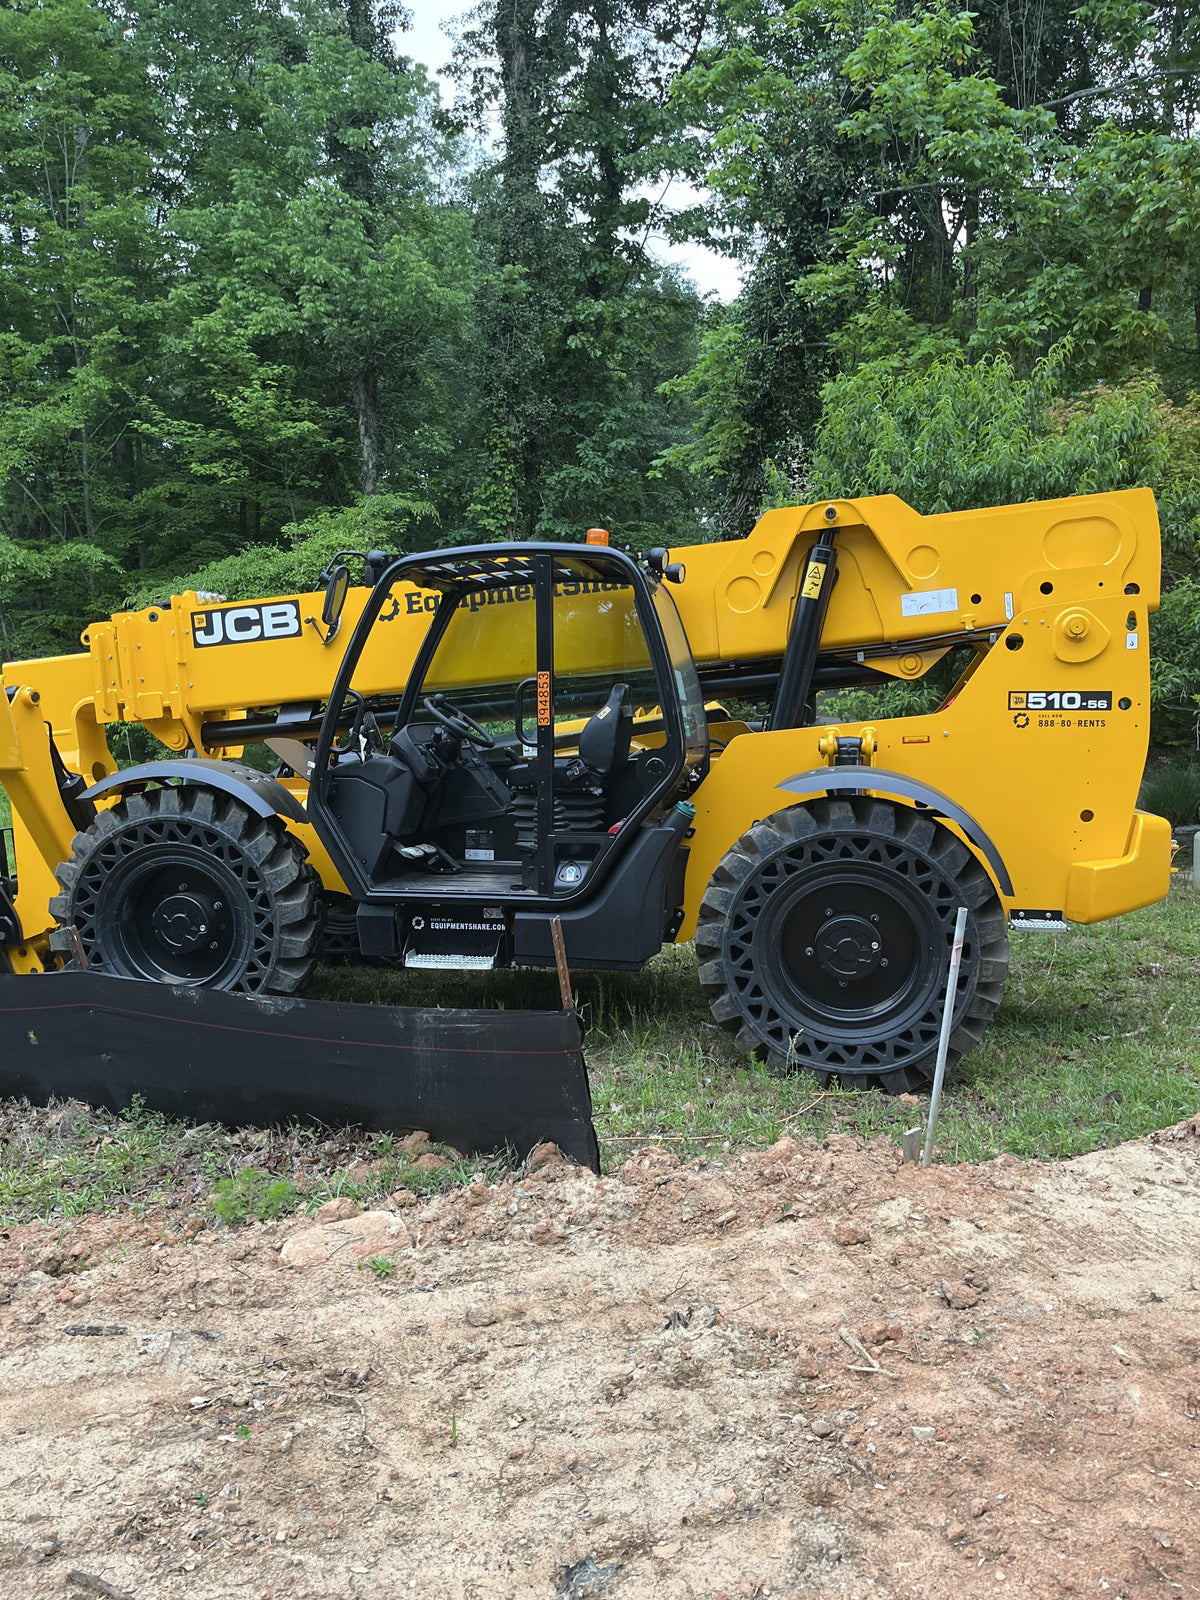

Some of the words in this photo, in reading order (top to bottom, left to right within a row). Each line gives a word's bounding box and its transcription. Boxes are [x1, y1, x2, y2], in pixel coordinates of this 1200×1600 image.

[195, 603, 299, 645] JCB
[538, 673, 550, 724] 394853
[1027, 692, 1108, 709] 510-56
[1038, 719, 1106, 728] 888-80-RENTS
